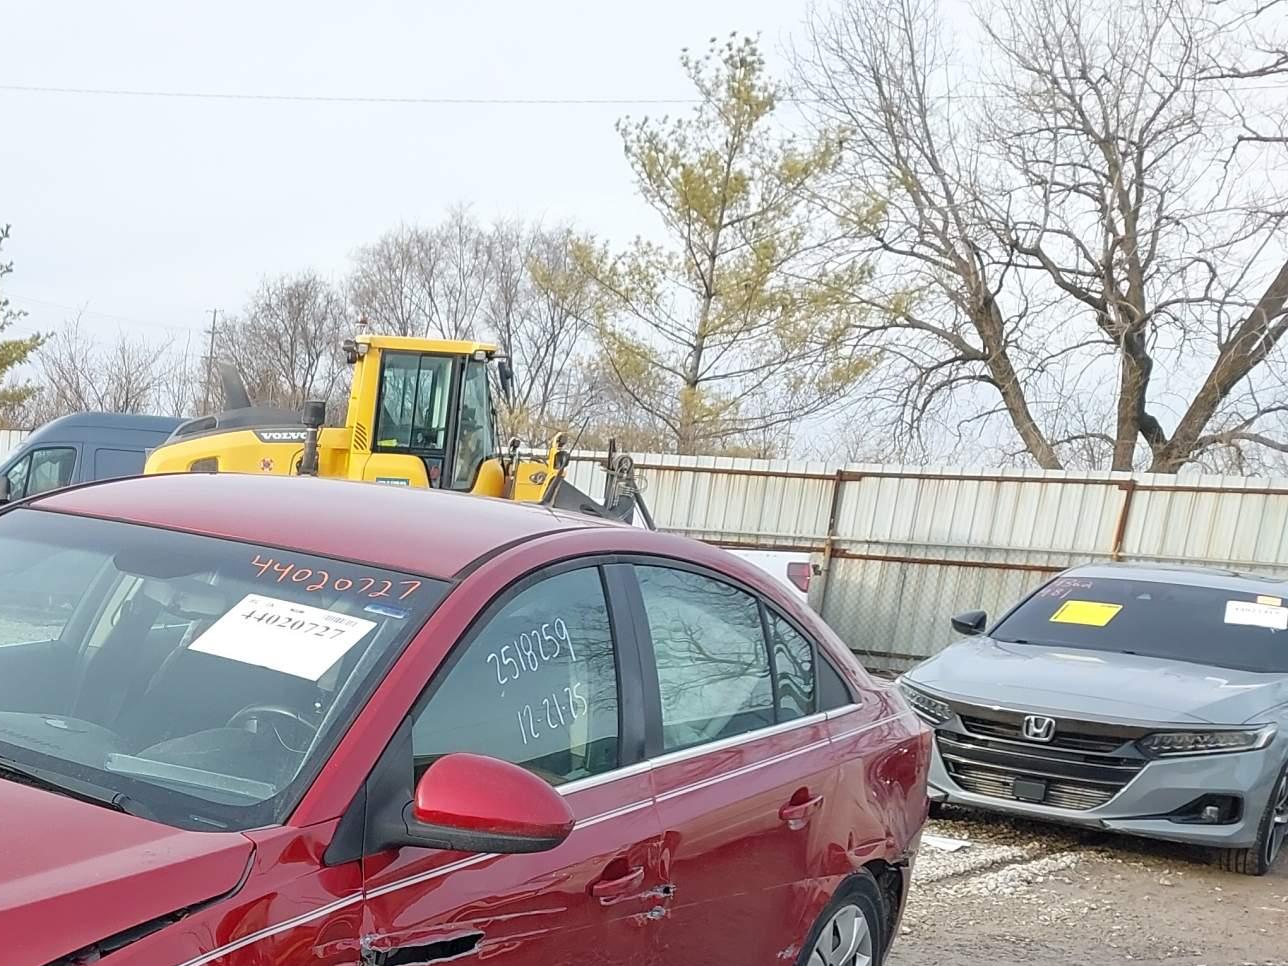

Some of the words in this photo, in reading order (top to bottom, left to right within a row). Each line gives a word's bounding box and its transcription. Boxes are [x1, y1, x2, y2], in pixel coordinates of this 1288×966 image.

[252, 555, 422, 600] 44020727
[241, 610, 346, 639] 44020727
[487, 618, 576, 684] 2518259
